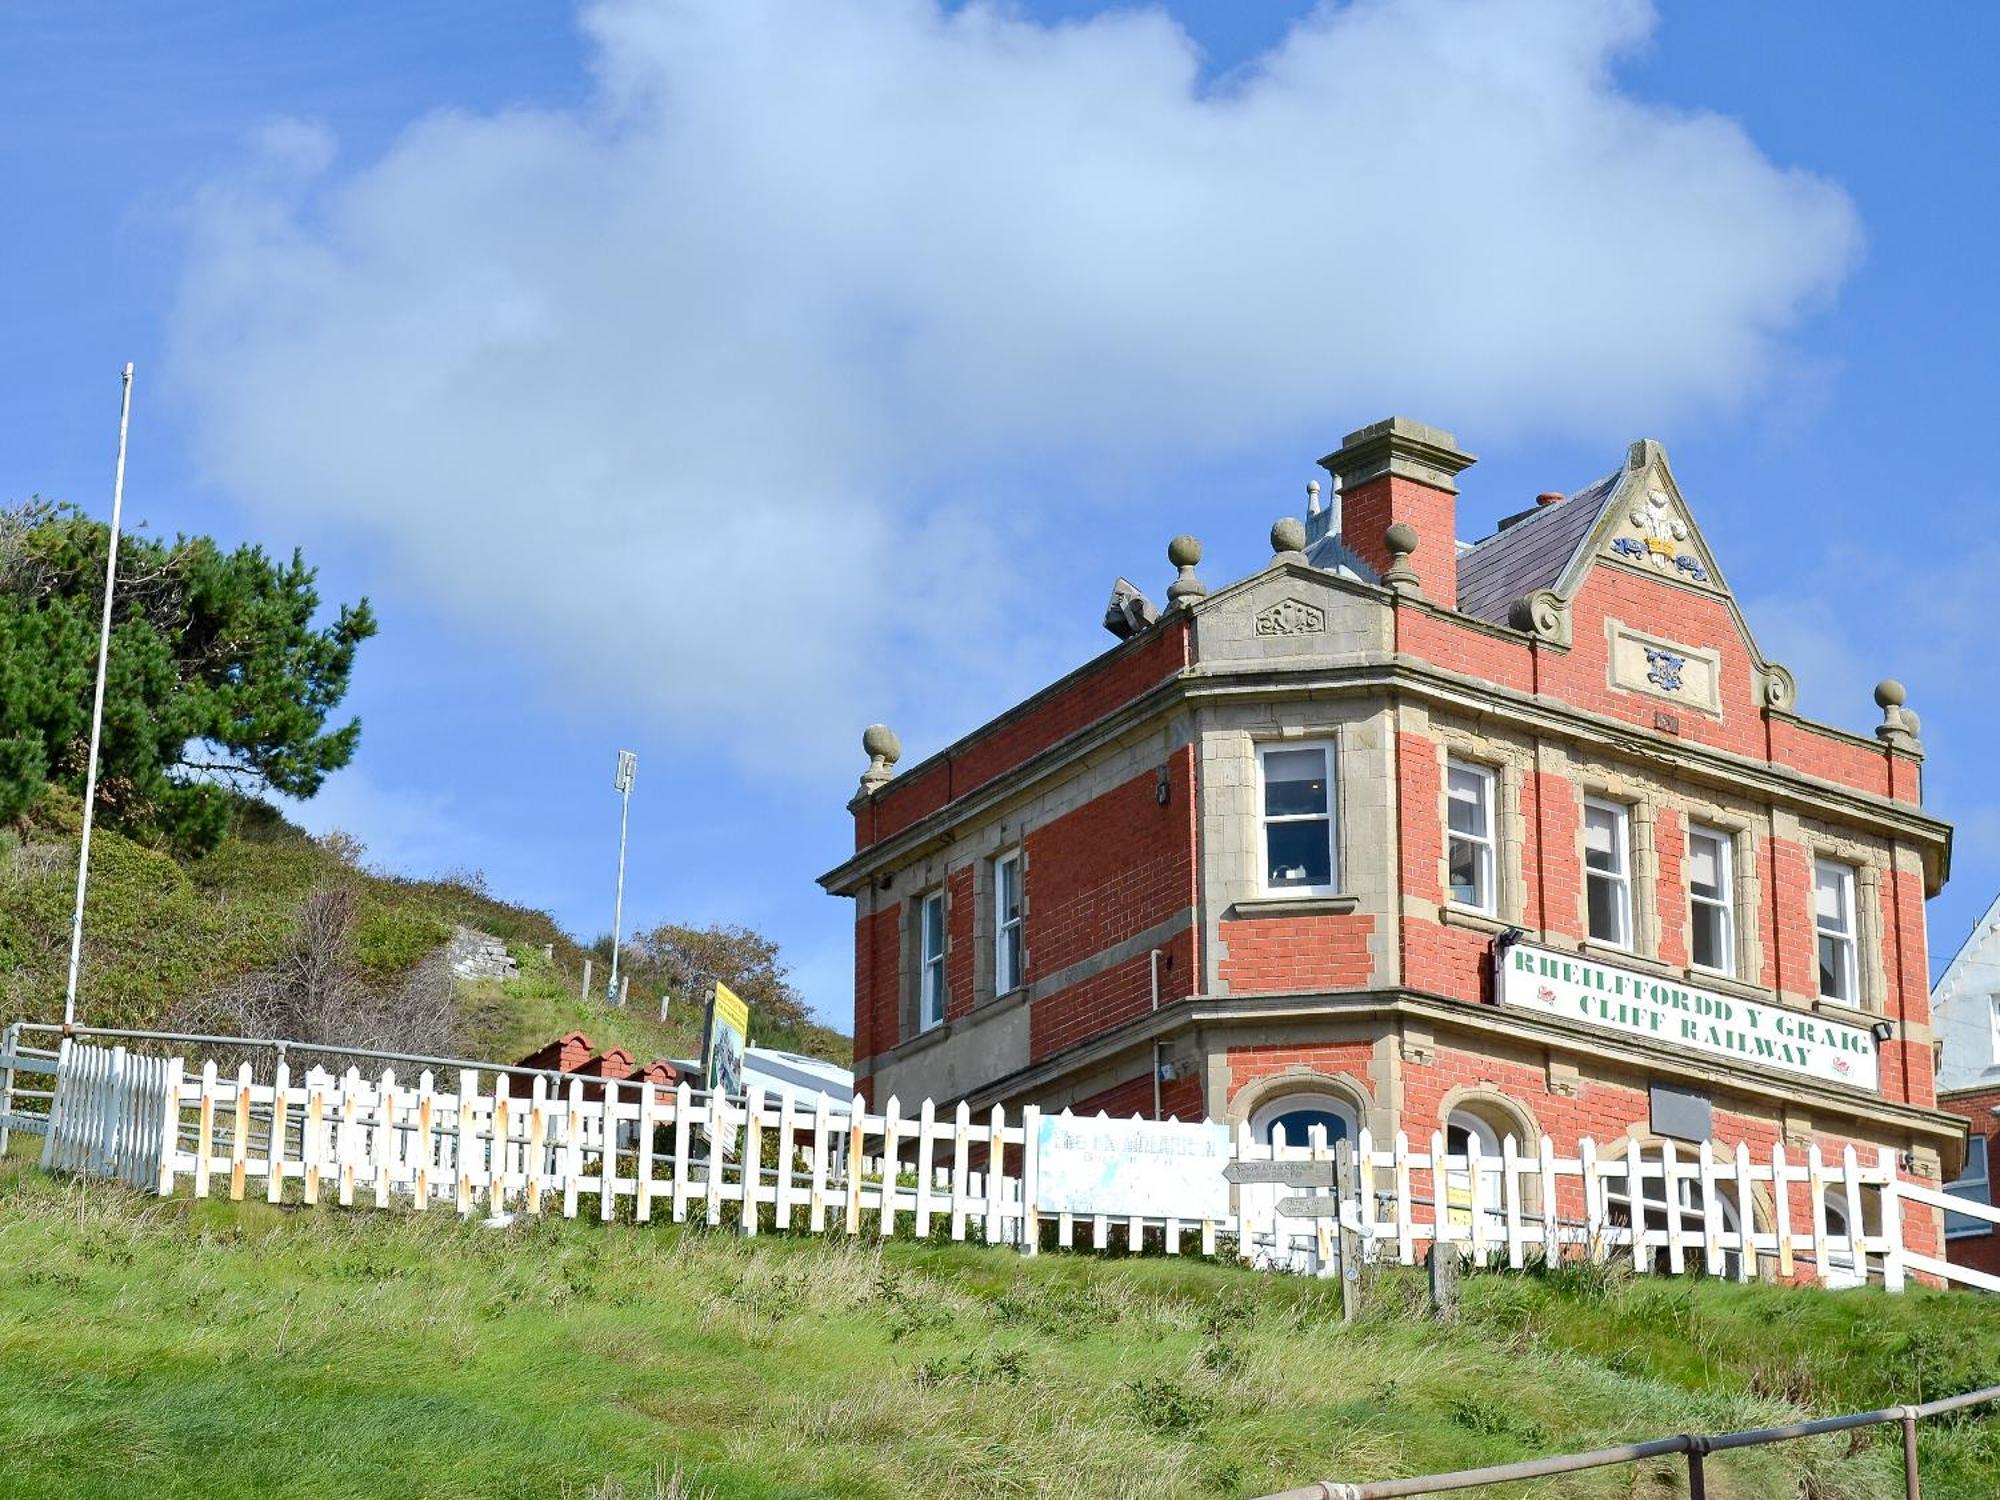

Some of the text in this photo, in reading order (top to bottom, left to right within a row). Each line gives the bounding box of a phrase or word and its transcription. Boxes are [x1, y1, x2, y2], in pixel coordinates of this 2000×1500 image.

[1515, 951, 1869, 1054] RHEILFFORDD Y GRAIG
[1579, 994, 1812, 1066] CLIFF RAILWAY
